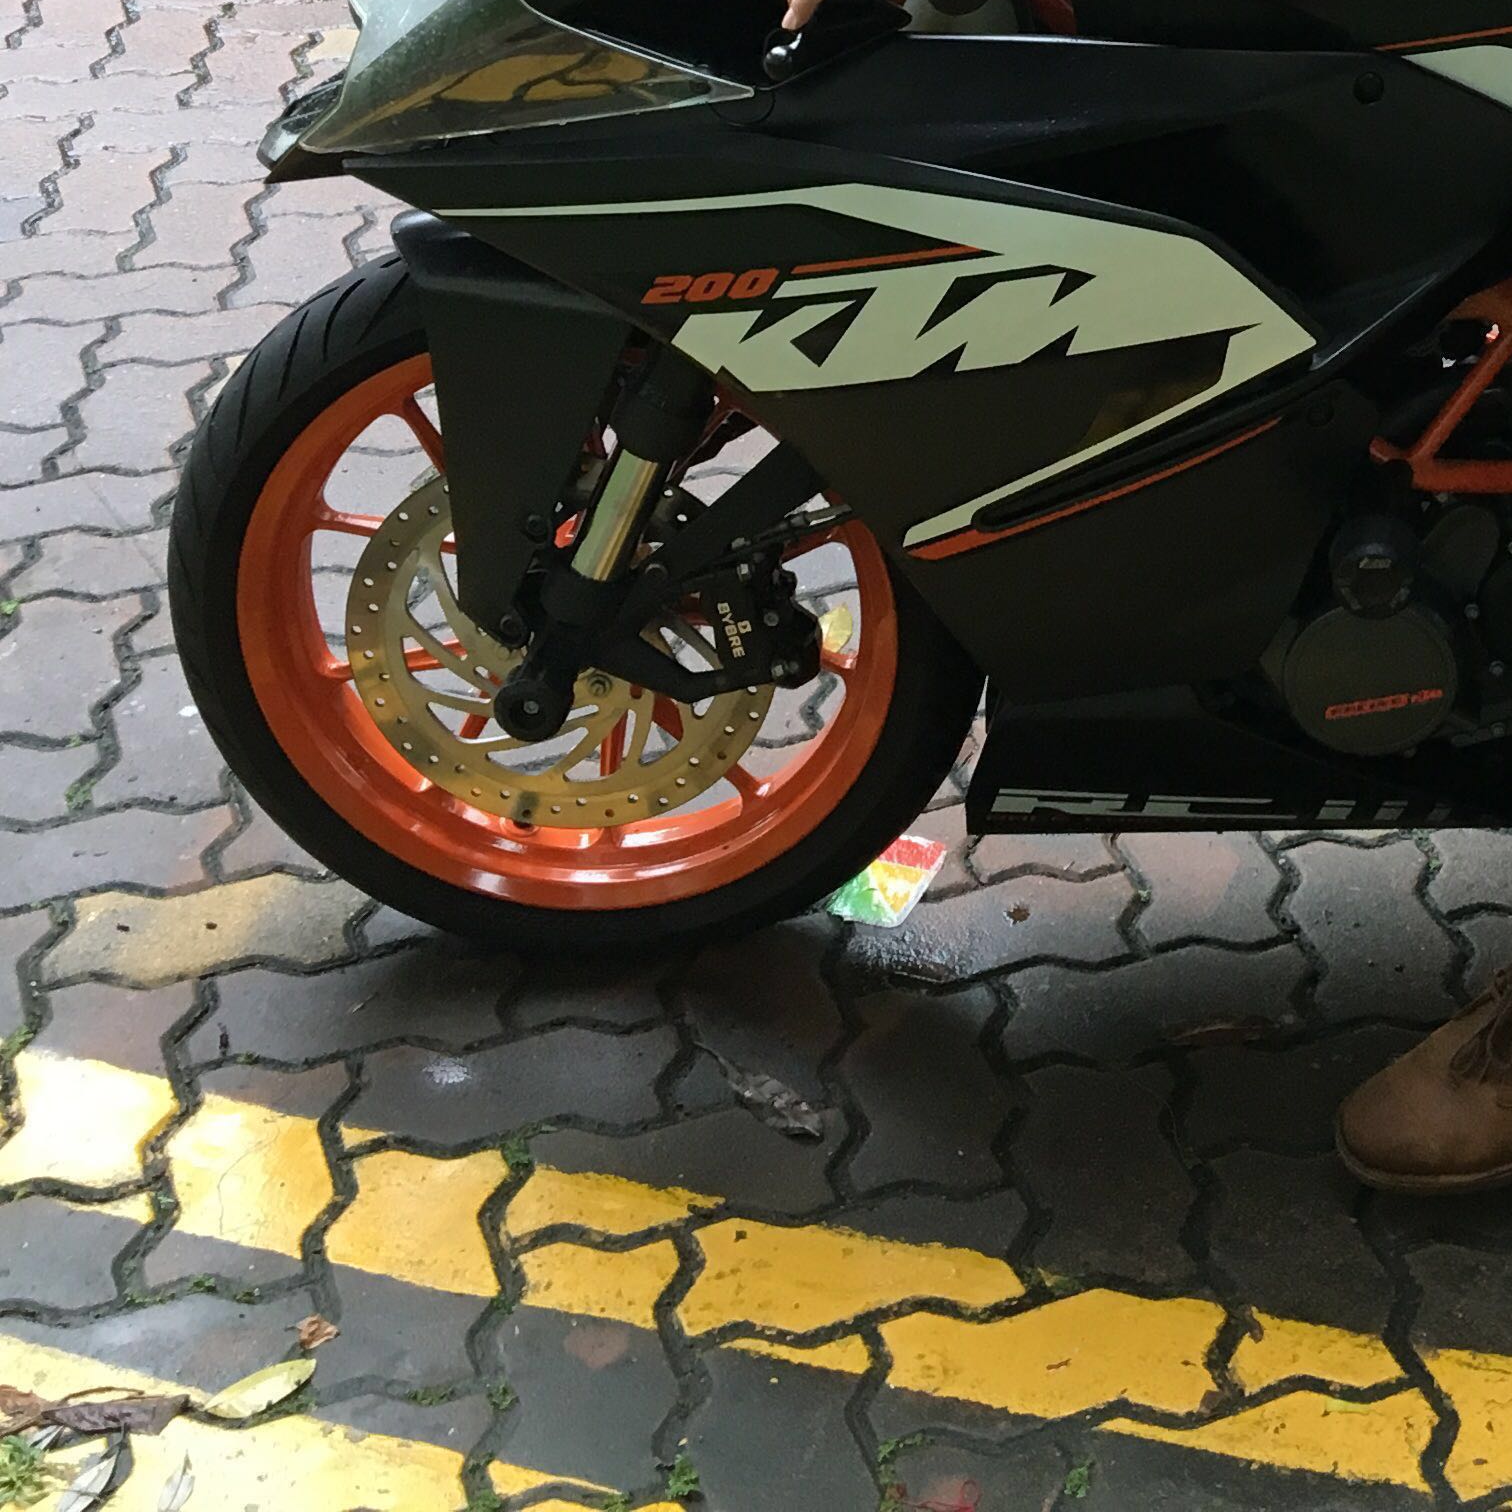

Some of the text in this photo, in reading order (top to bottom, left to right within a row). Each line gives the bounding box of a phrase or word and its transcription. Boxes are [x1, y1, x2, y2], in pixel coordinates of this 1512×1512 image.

[641, 267, 780, 304] 200
[671, 254, 1160, 392] KTM
[717, 602, 746, 659] BYBRE
